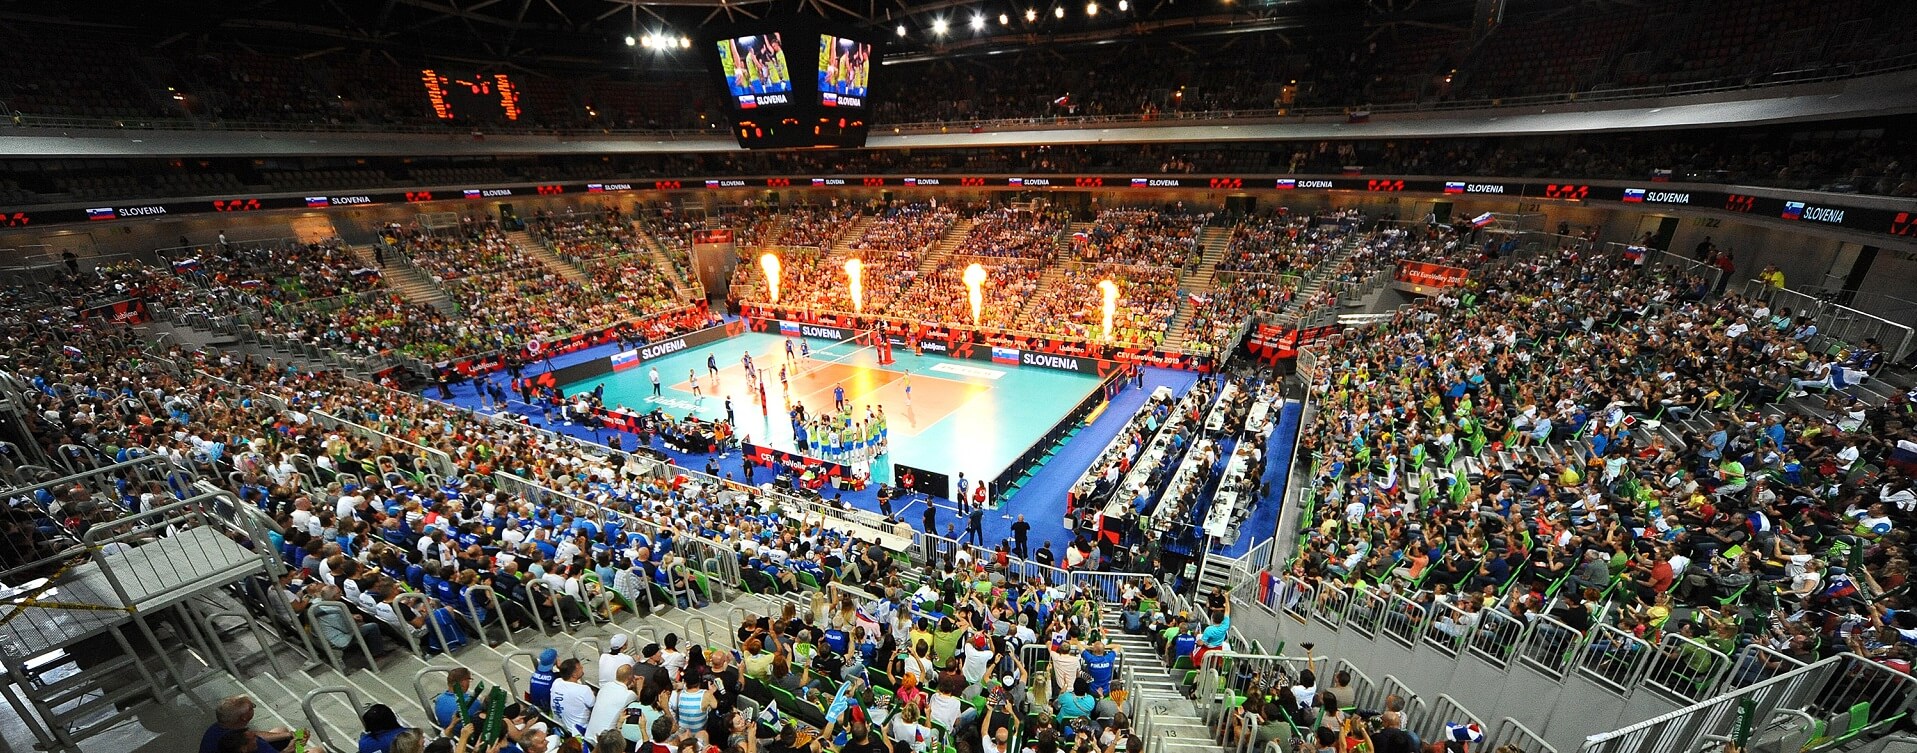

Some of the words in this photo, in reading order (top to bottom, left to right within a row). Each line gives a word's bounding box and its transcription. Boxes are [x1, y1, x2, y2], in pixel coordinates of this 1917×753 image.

[757, 94, 788, 106] SLOVENIA
[837, 96, 862, 107] SLOVENIA
[1466, 184, 1504, 194] SLOVENIA
[331, 196, 371, 206] SLOVENIA
[1646, 192, 1690, 204] SLOVENIA
[118, 206, 167, 216] SLOVENIA
[1803, 207, 1844, 223] SLOVENIA
[1420, 272, 1447, 283] EuroVolley
[113, 310, 138, 322] Ljubljana
[802, 326, 842, 339] SLOVENIA
[641, 338, 687, 360] SLOVENIA
[921, 341, 946, 351] Ljubljana
[1023, 353, 1079, 370] SLOVENIA
[1116, 351, 1130, 359] CEV
[1131, 353, 1163, 363] EuroVolley
[1164, 356, 1180, 365] 2019
[469, 360, 498, 373] Ljubljana
[761, 452, 774, 461] CEV
[1152, 705, 1169, 716] 12
[1165, 730, 1177, 738] 13
